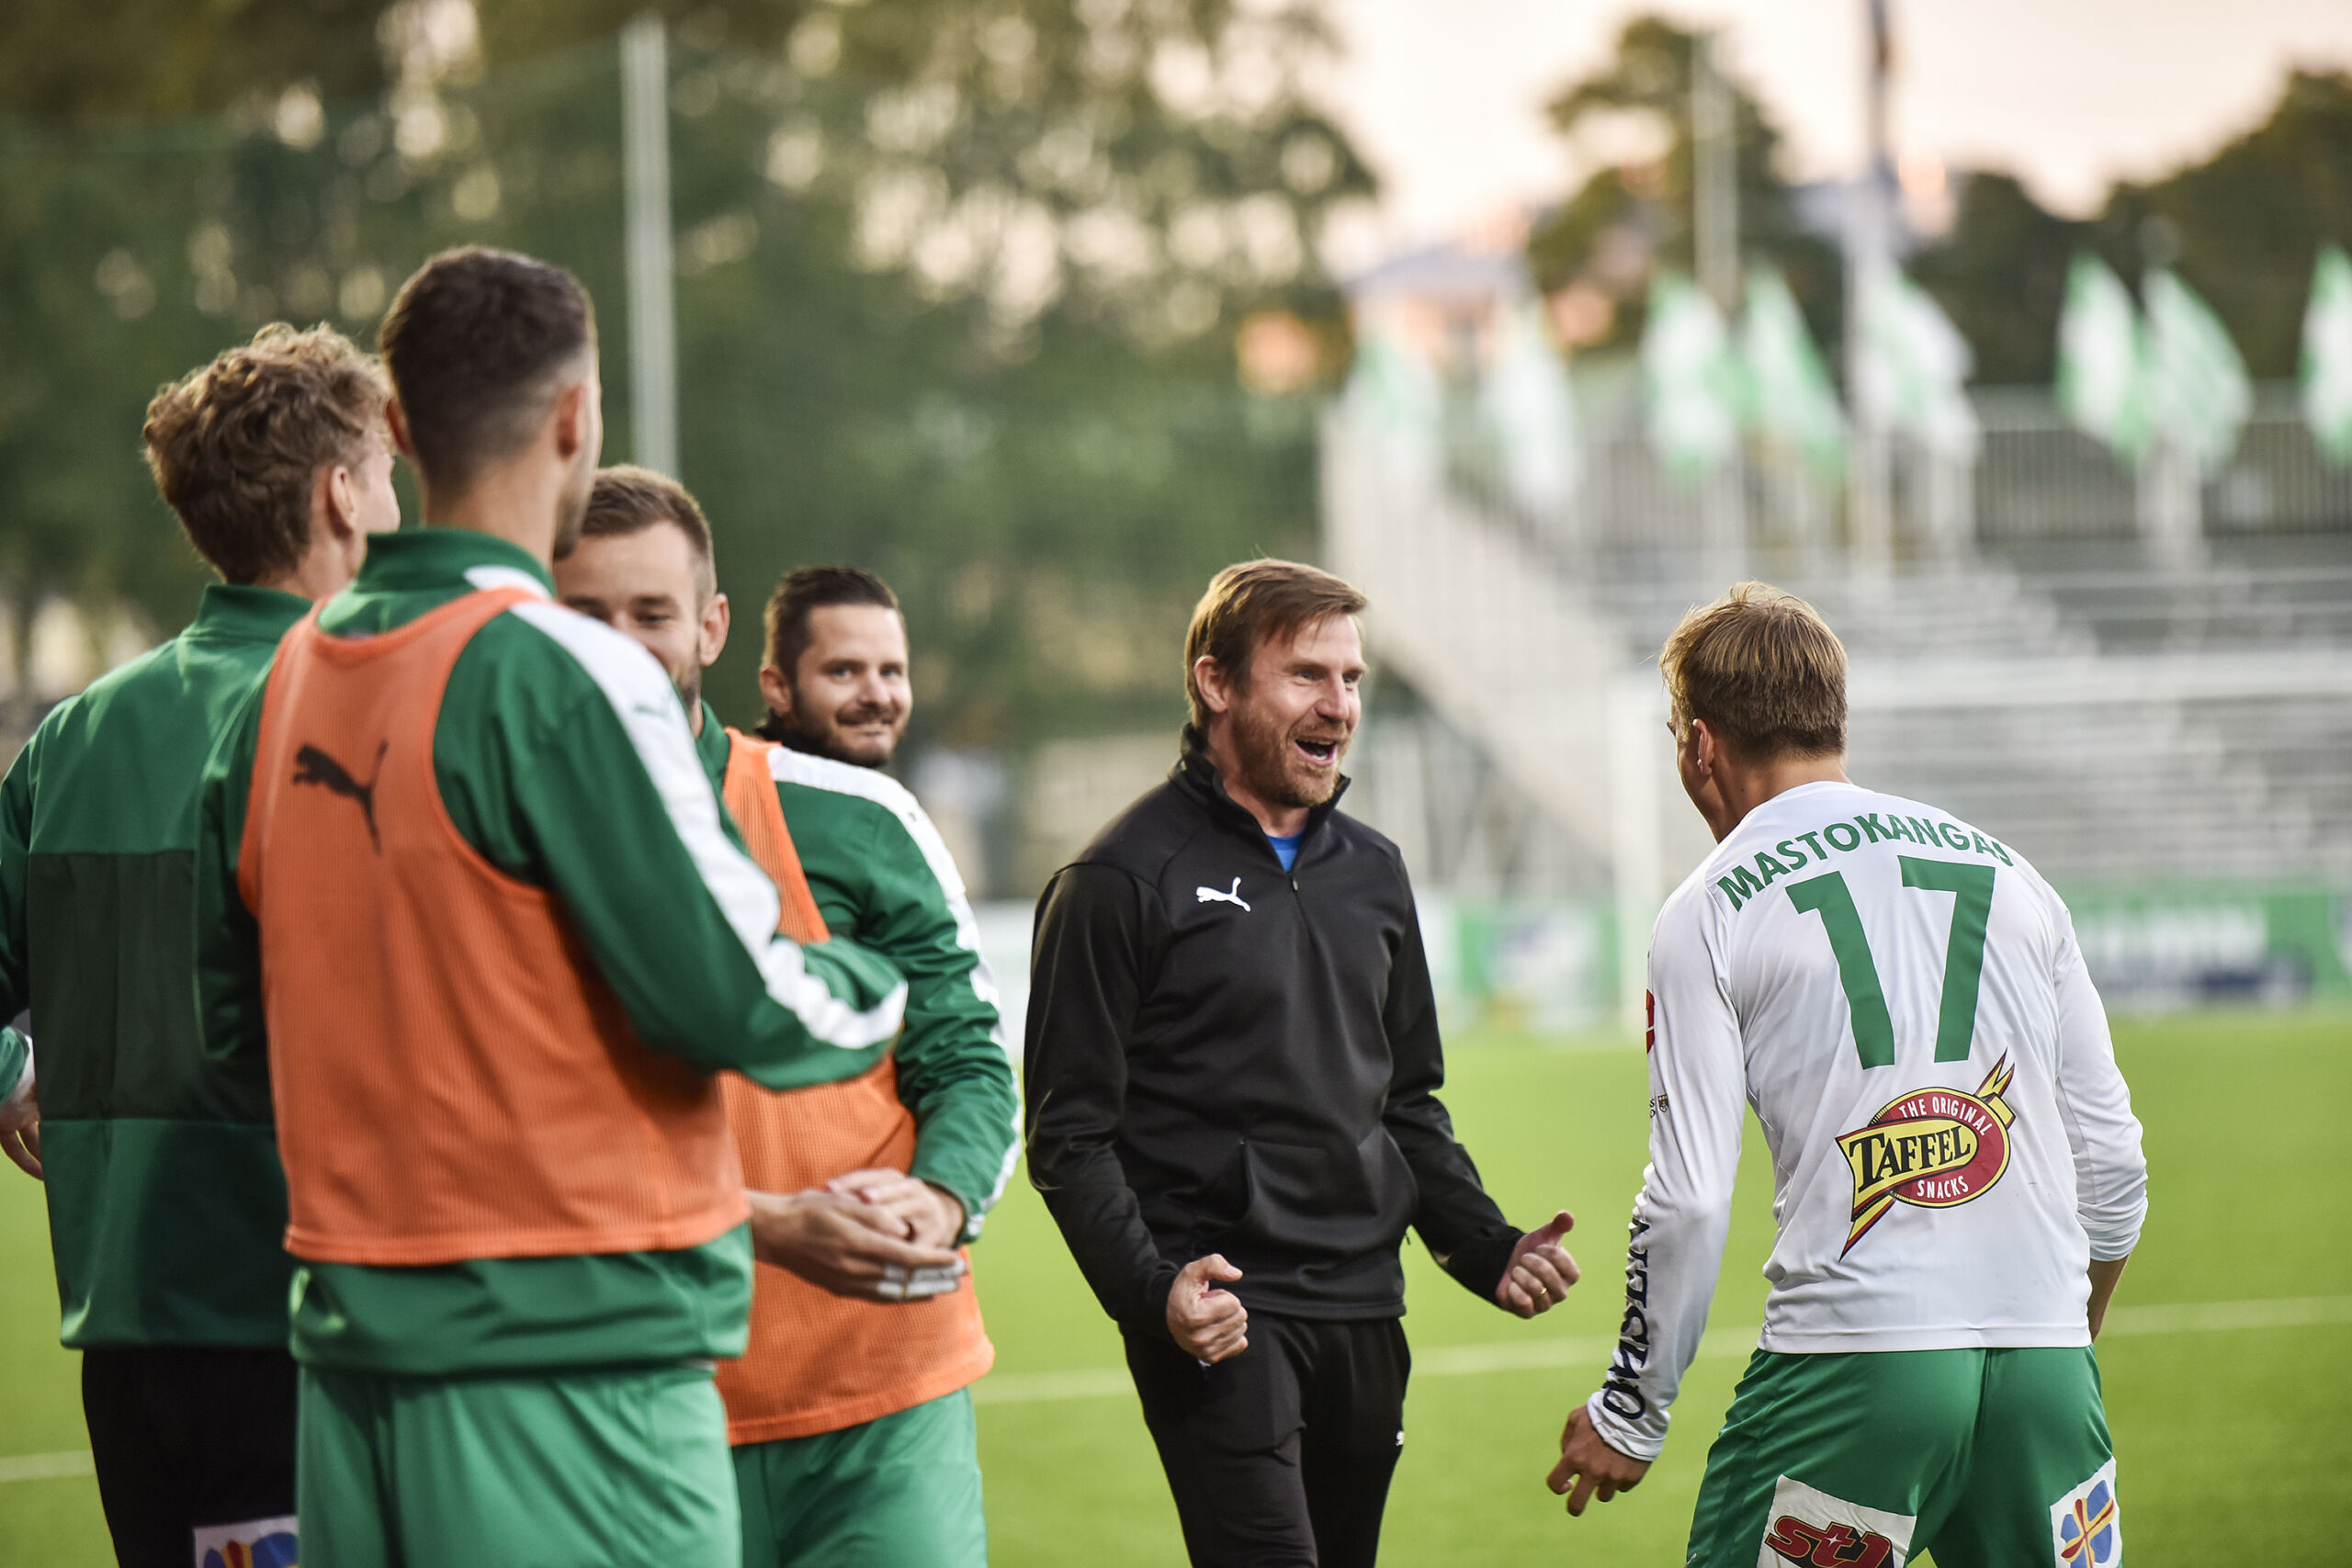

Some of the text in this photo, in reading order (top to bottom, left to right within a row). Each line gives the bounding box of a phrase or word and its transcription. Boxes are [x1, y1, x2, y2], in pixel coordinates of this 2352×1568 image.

[1785, 854, 1996, 1070] 17
[1898, 1096, 1994, 1136] THE ORIGINAL
[1849, 1125, 1971, 1193] TAFFEL
[1917, 1175, 1969, 1199] SNACKS
